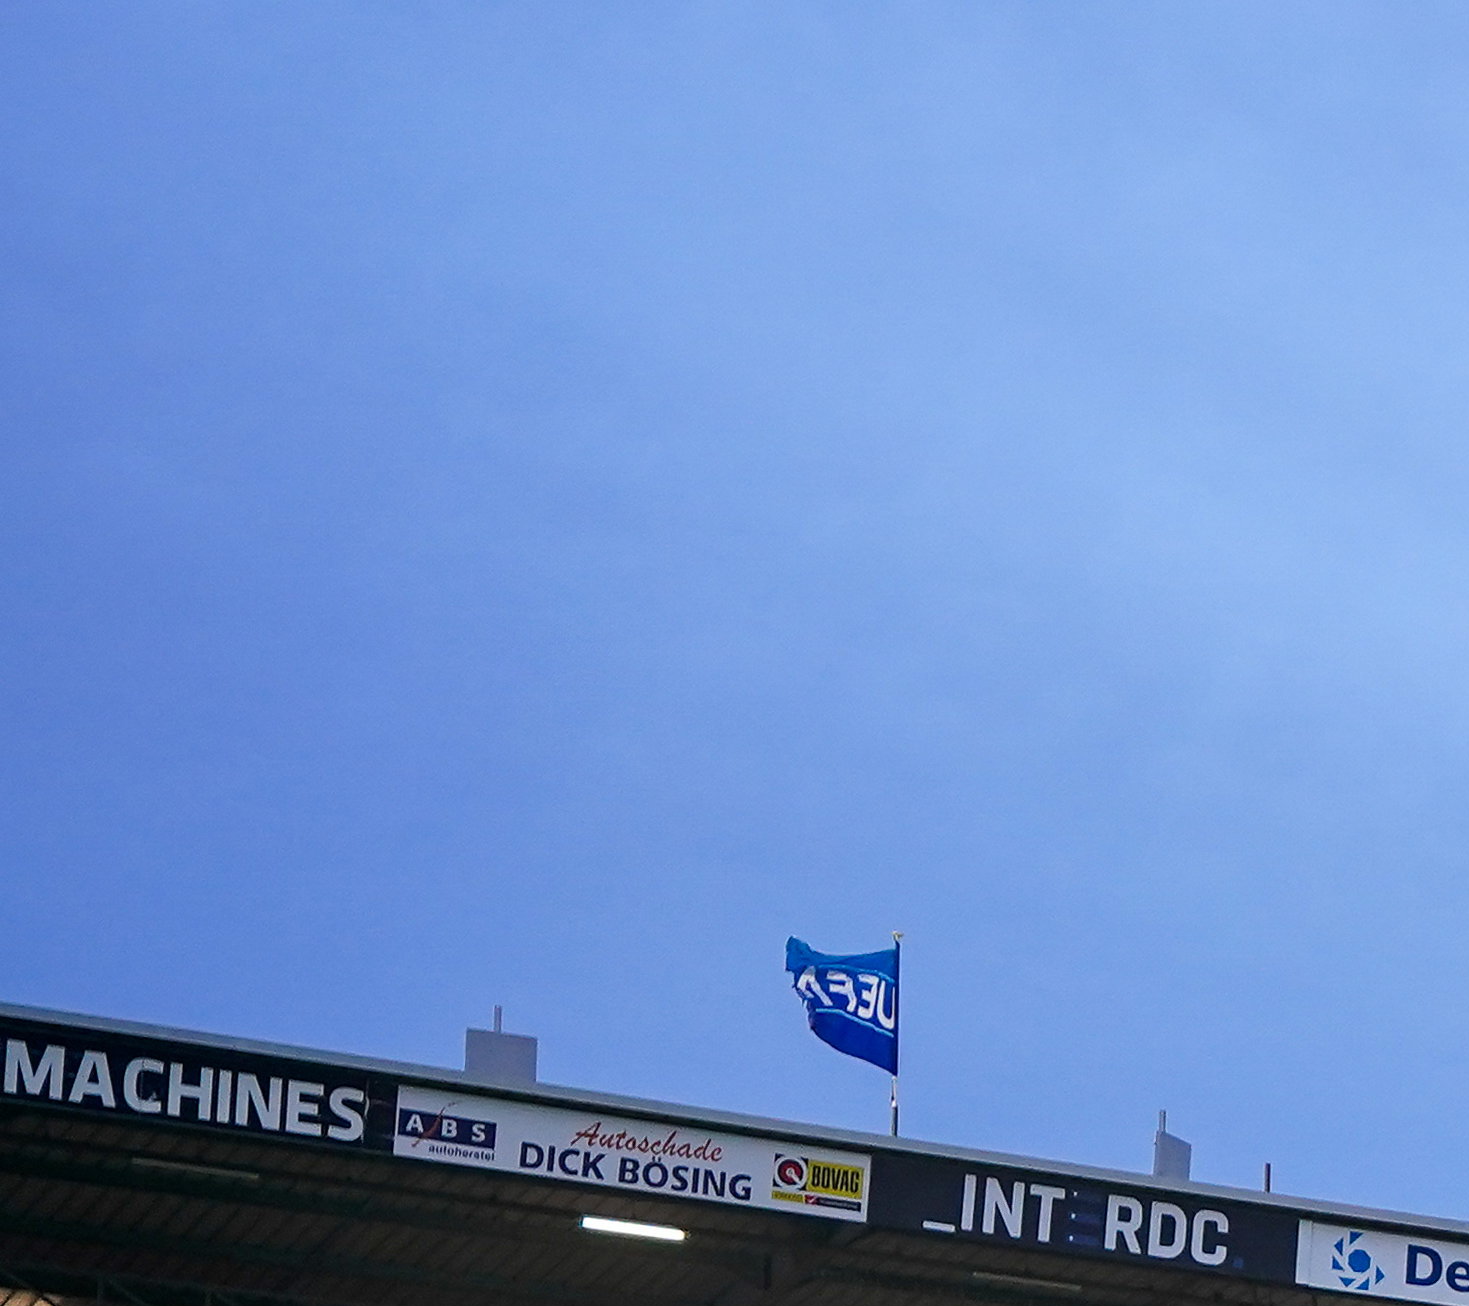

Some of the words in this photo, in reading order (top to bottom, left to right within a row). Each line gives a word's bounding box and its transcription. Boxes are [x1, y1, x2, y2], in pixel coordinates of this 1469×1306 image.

[2, 1038, 367, 1143] MACHINES
[405, 1112, 487, 1144] ABS
[570, 1121, 724, 1163] Autoschade
[519, 1140, 606, 1182] DICK
[618, 1154, 753, 1203] BÖSING
[811, 1165, 861, 1195] BOVAG
